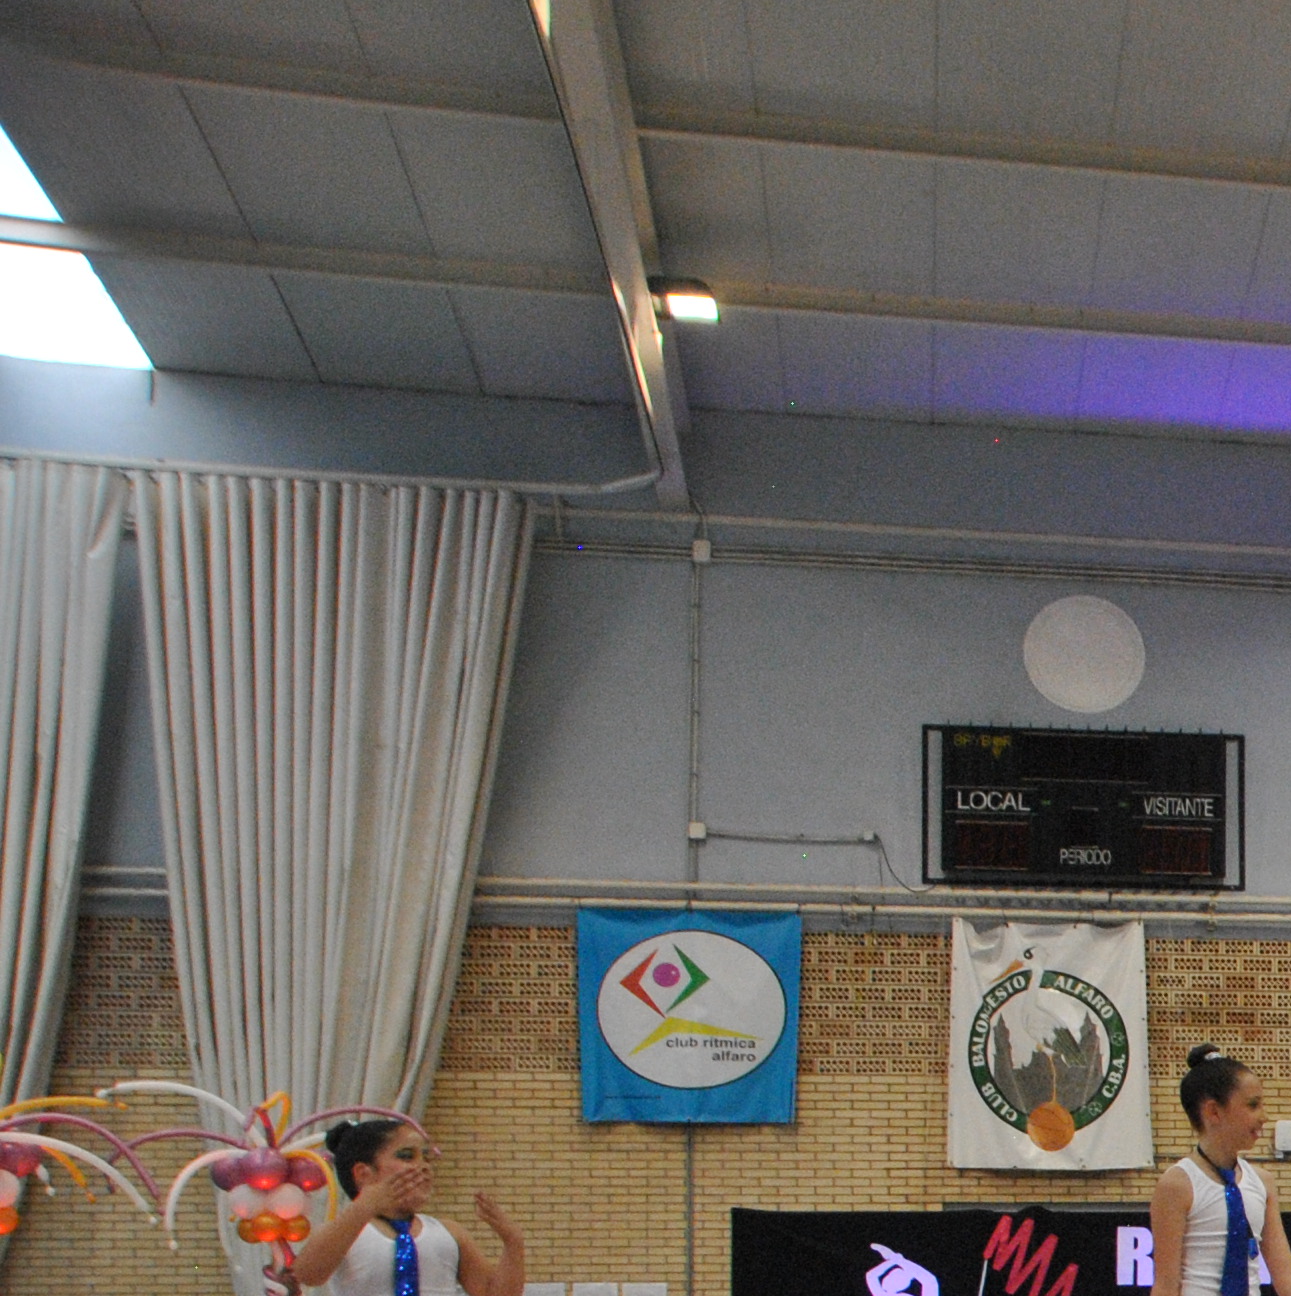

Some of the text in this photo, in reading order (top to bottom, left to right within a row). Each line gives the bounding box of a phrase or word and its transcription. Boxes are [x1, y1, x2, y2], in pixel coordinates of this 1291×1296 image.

[956, 791, 1031, 812] LOCAL
[1143, 797, 1214, 817] VISITANTE
[1059, 849, 1112, 866] PERIODO
[666, 1037, 698, 1049] club
[981, 1083, 1018, 1122] CLUB
[1053, 975, 1115, 1020] ALFARO
[711, 1051, 756, 1063] alfaro
